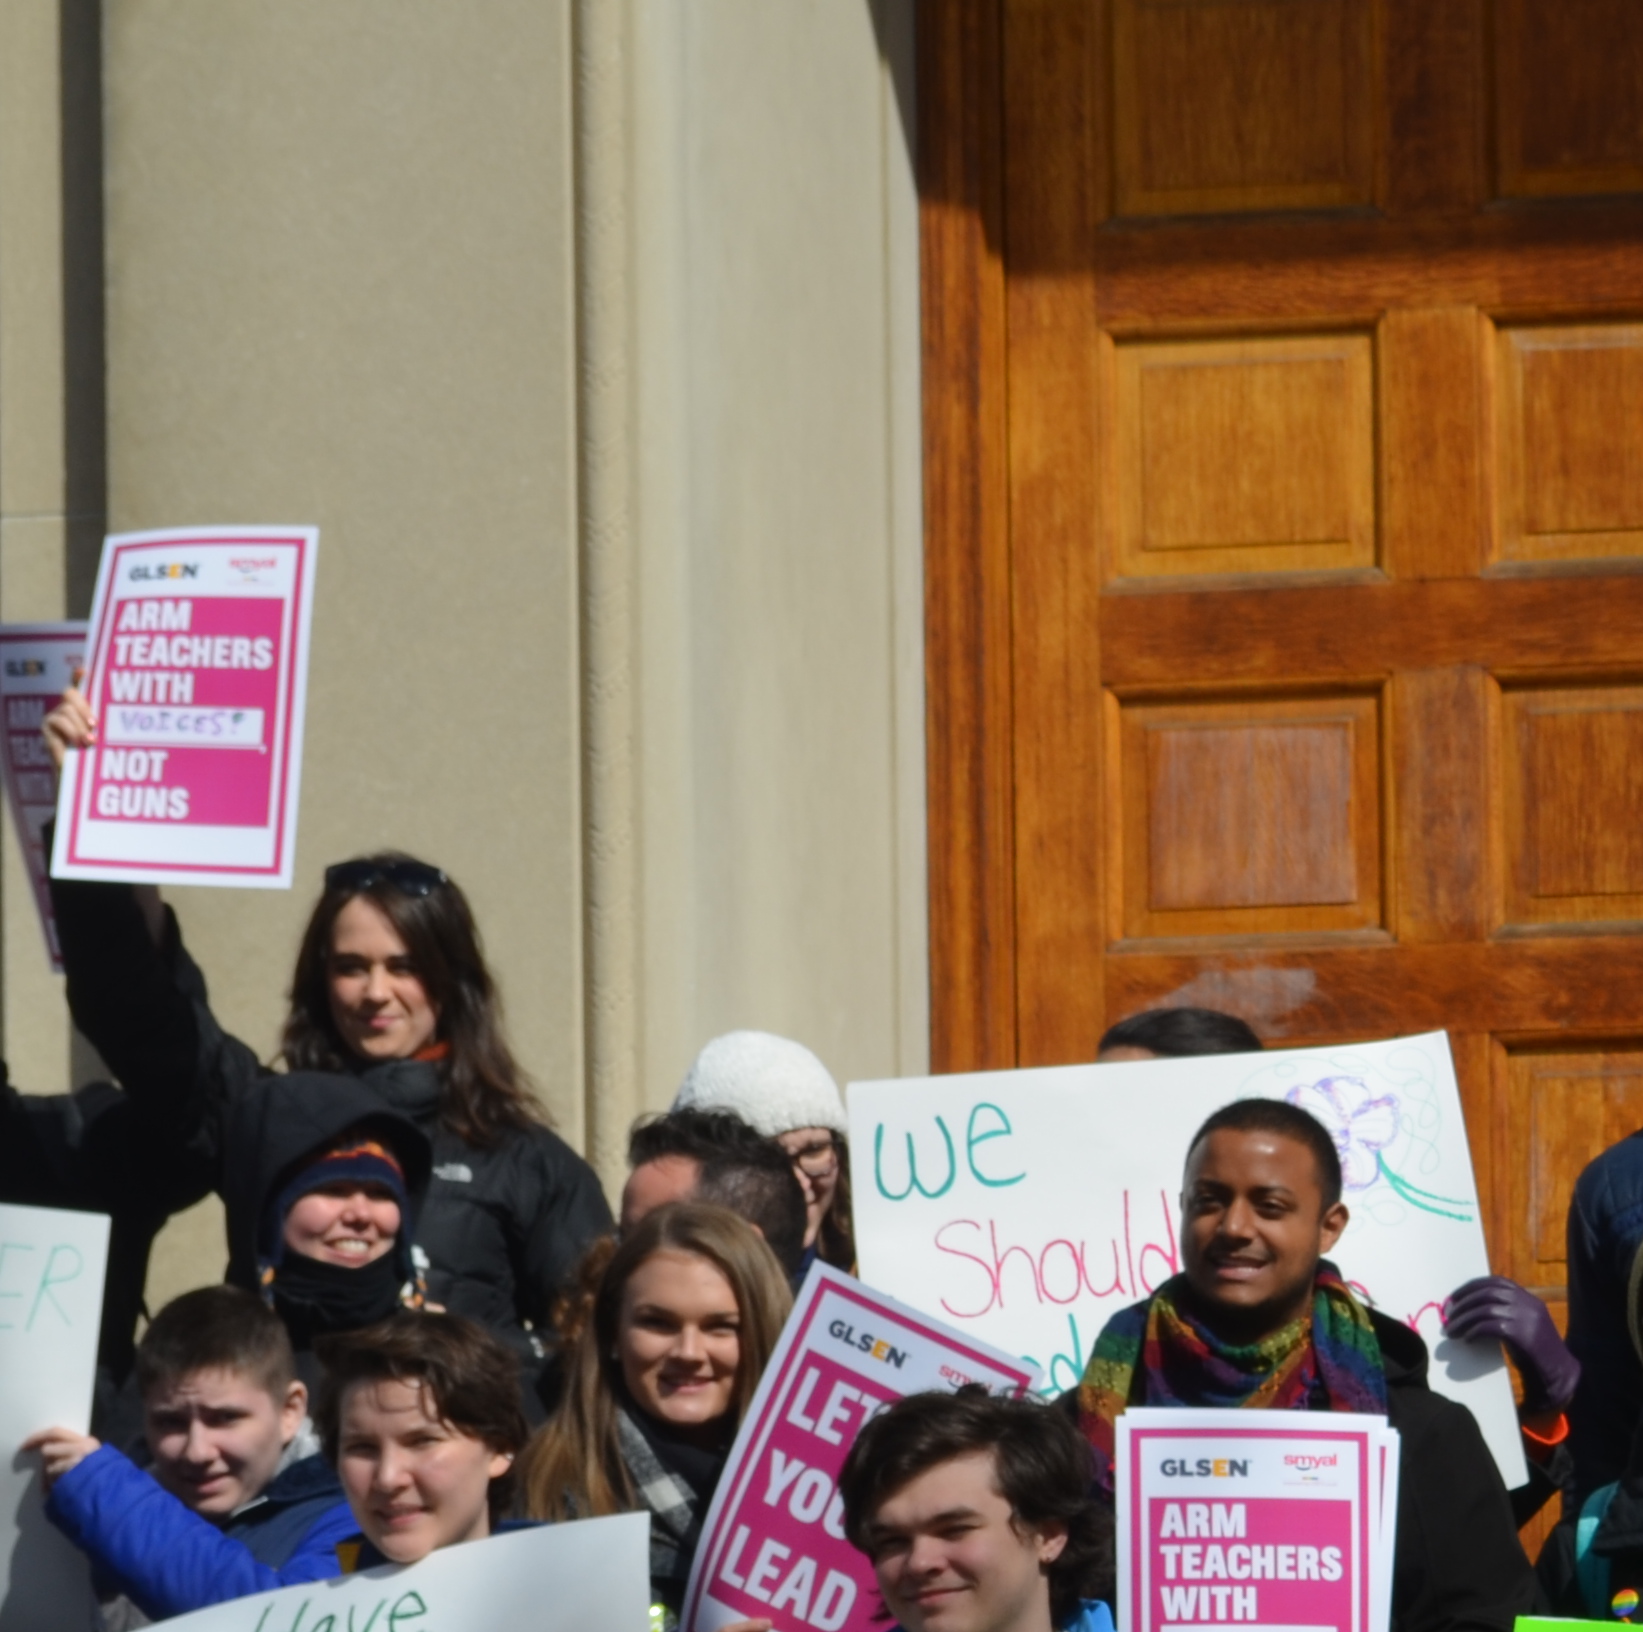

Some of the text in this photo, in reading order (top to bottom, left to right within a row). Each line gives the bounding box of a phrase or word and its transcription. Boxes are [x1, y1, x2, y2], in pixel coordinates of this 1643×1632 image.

[129, 562, 200, 582] GLSEN
[117, 600, 192, 631] ARM
[113, 636, 273, 671] TEACHERS
[109, 670, 195, 704] WITH
[101, 748, 169, 782] NOT
[96, 785, 190, 820] GUNS
[934, 1189, 1182, 1319] Should
[827, 1319, 907, 1369] GLSEN
[1160, 1453, 1338, 1478] GLSEN smyal
[1160, 1502, 1247, 1539] ARM
[1159, 1545, 1343, 1582] TEACHERS
[1161, 1586, 1258, 1621] WITH
